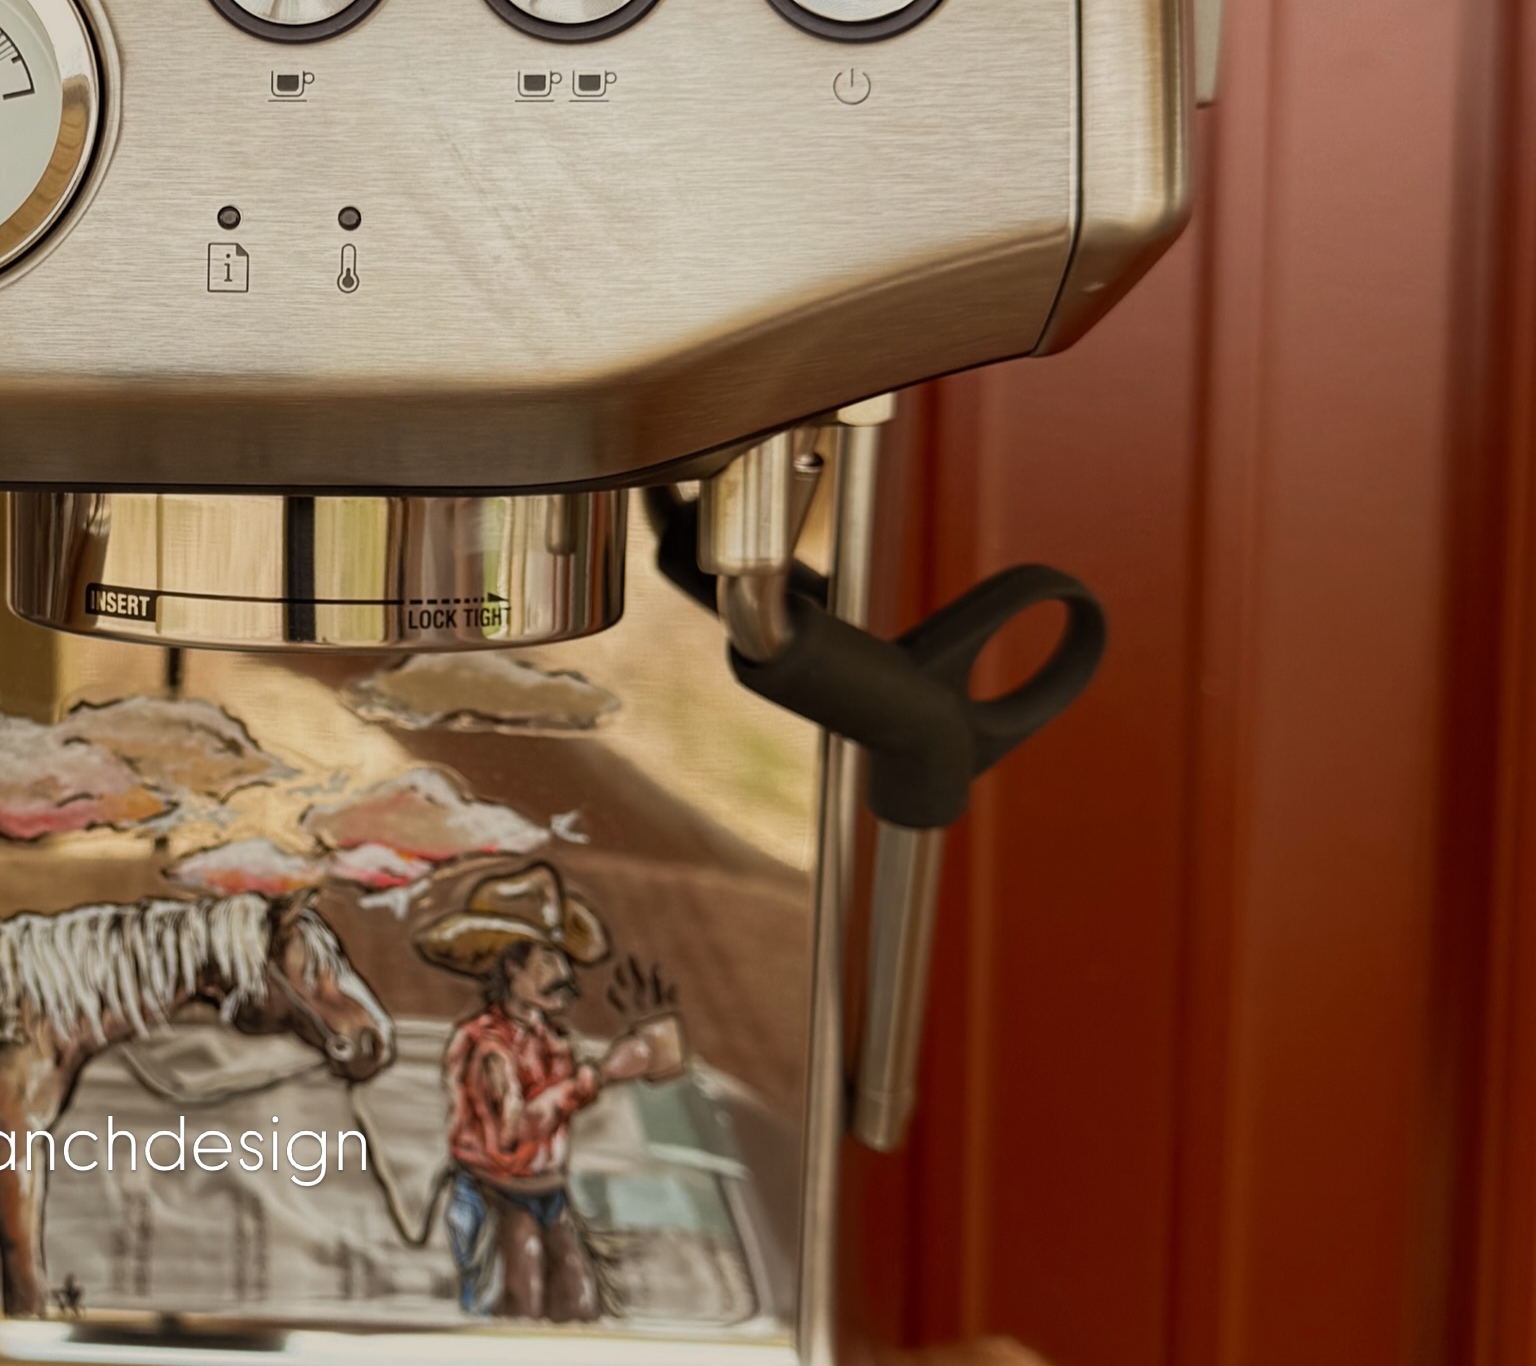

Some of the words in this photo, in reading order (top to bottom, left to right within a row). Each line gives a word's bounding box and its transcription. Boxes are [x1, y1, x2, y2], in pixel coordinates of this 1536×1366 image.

[89, 589, 151, 618] INSERT
[407, 608, 457, 630] LOCK
[463, 605, 512, 629] TIGHT
